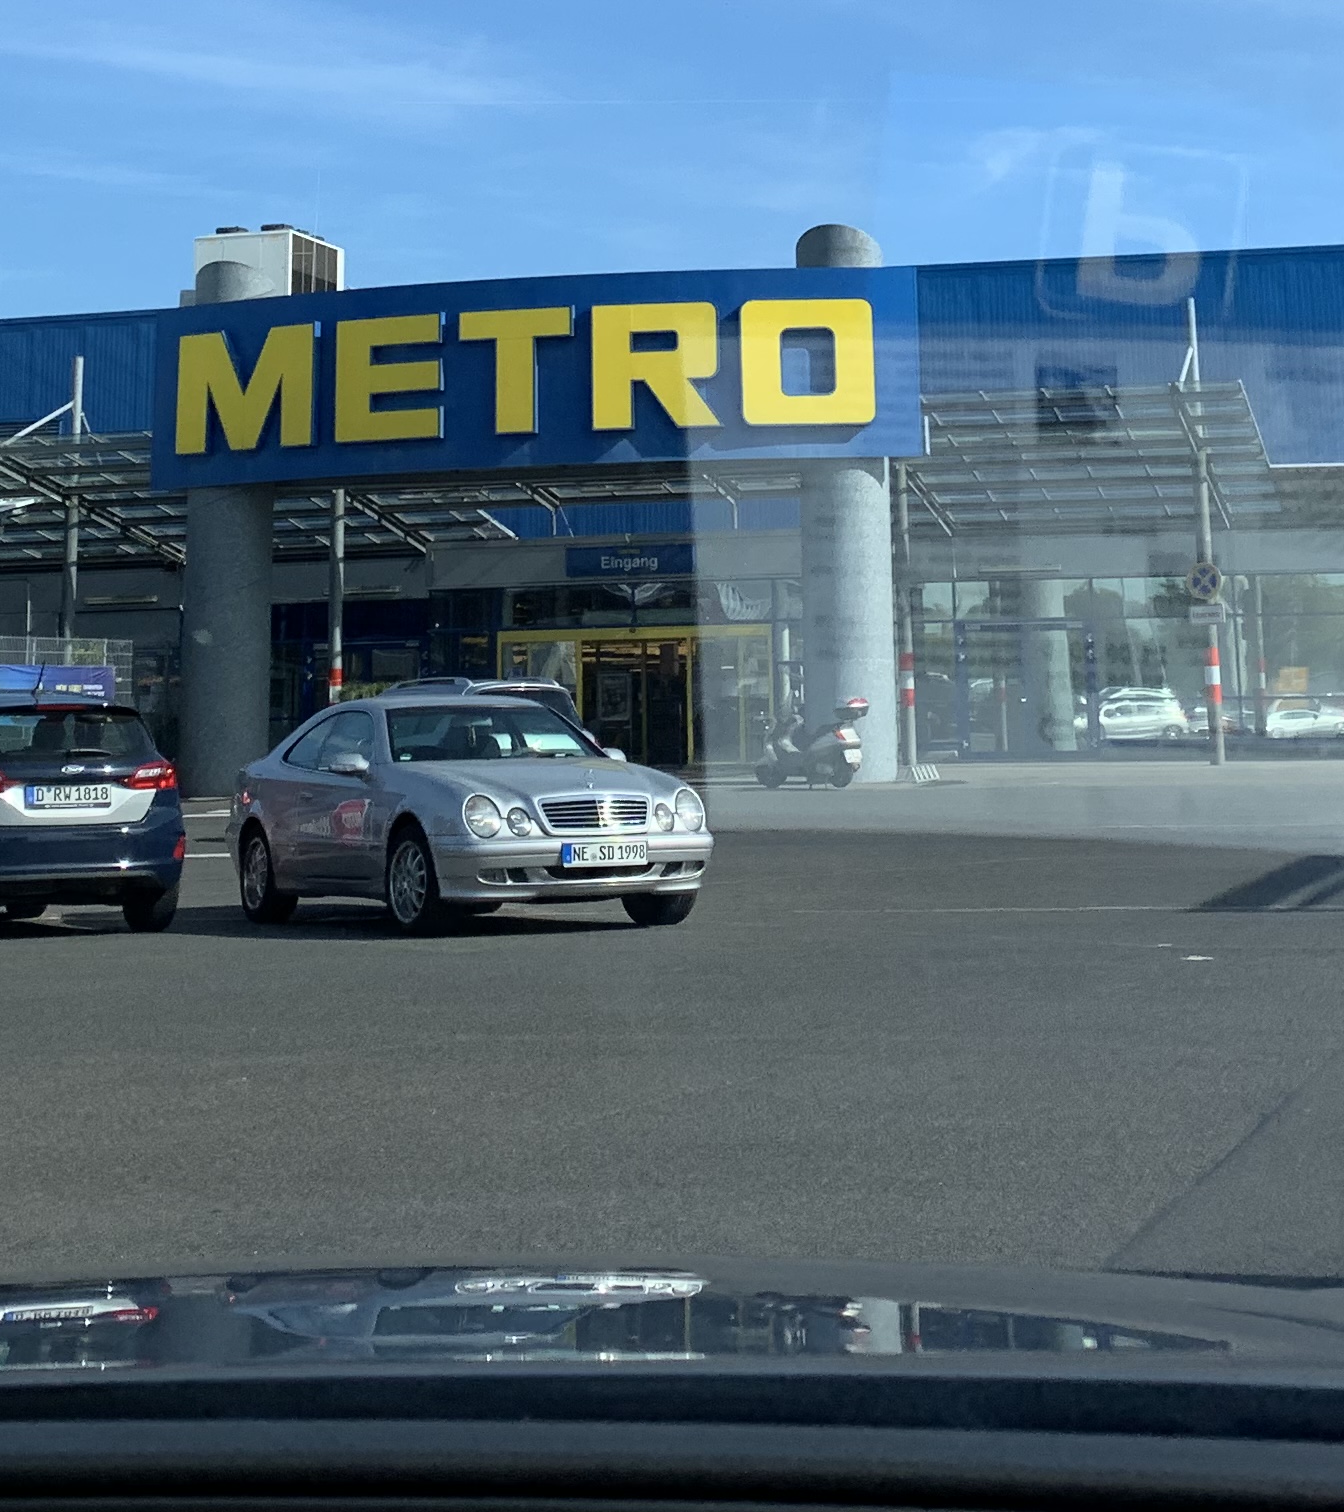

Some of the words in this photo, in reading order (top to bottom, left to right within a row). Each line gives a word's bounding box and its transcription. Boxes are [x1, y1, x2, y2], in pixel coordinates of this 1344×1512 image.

[175, 298, 877, 456] METRO
[601, 556, 659, 571] Eingang
[36, 788, 44, 802] D
[54, 787, 72, 802] RW
[75, 787, 109, 801] 1818
[572, 846, 589, 862] NE
[599, 845, 615, 860] SD
[617, 844, 646, 860] 1998
